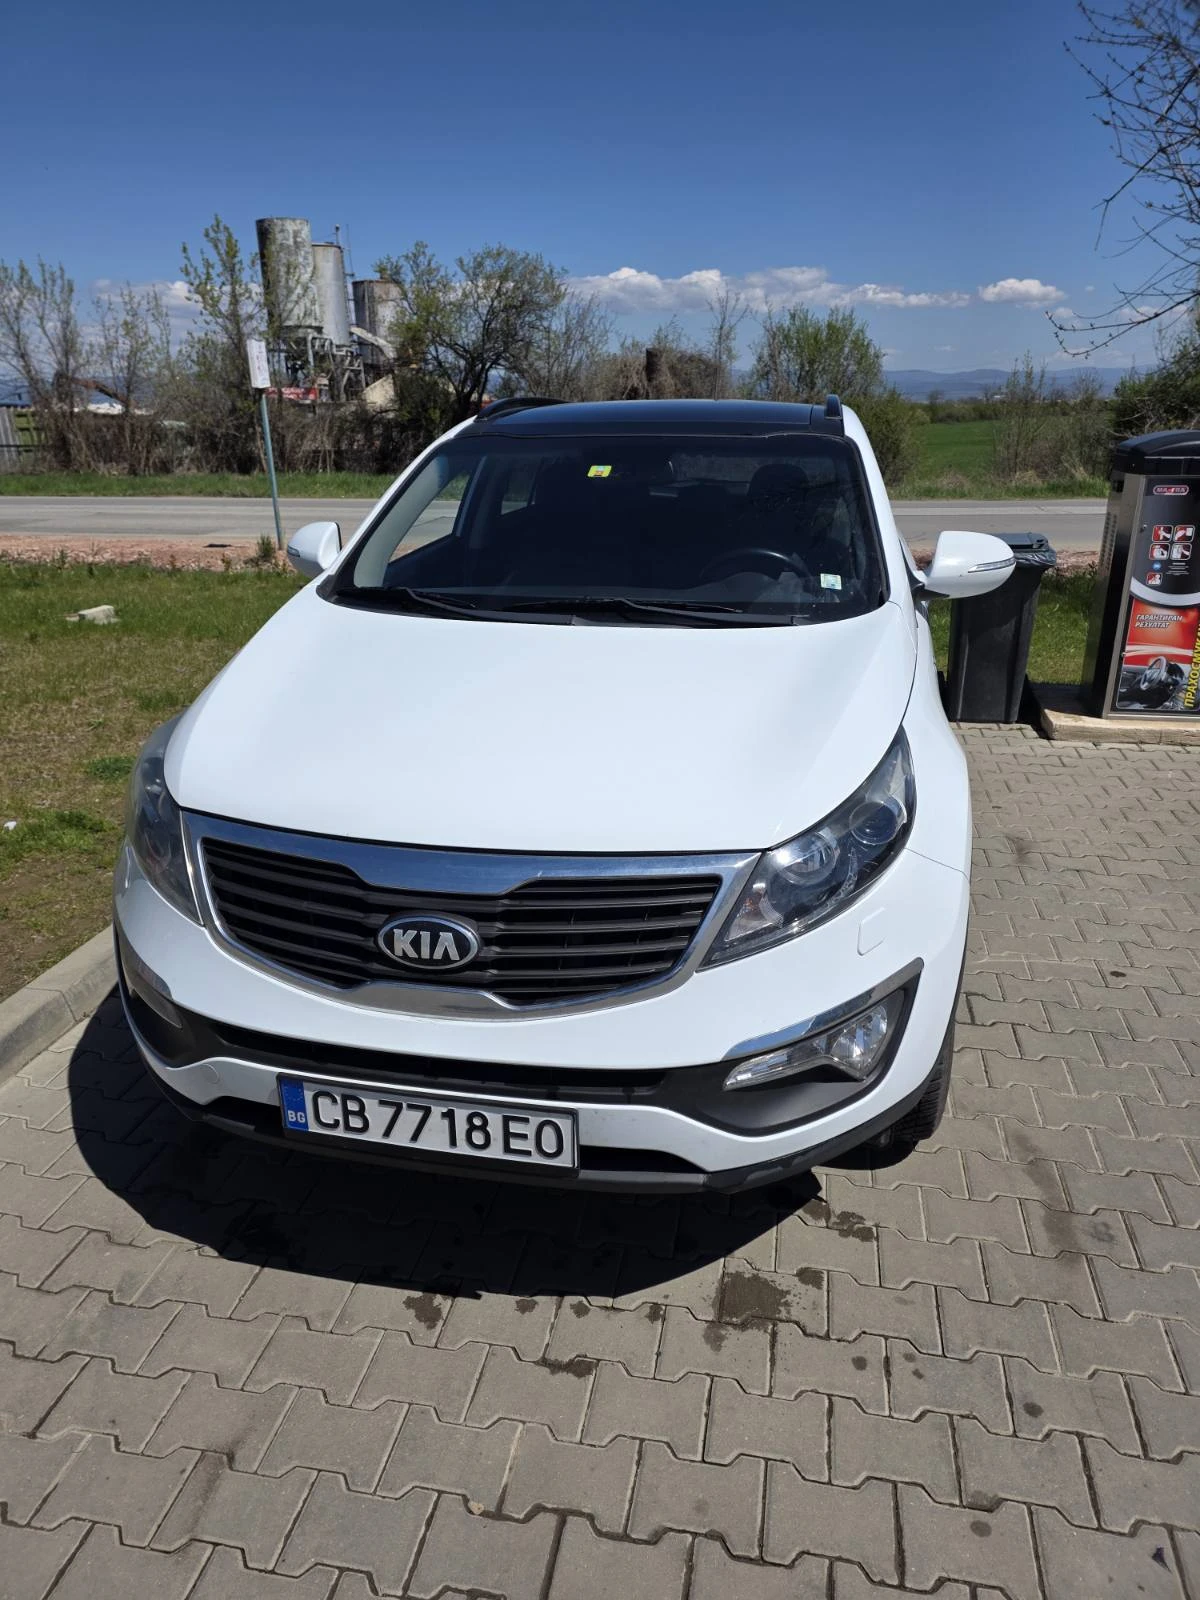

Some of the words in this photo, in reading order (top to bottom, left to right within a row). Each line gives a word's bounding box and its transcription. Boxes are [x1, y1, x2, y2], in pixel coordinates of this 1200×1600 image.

[1136, 614, 1183, 622] ГАРАНТИРАН
[1135, 621, 1170, 629] РЕЗУЛТАТ
[393, 928, 460, 960] KIA
[287, 1110, 306, 1123] BG
[312, 1090, 370, 1133] CB
[378, 1099, 491, 1150] 7718
